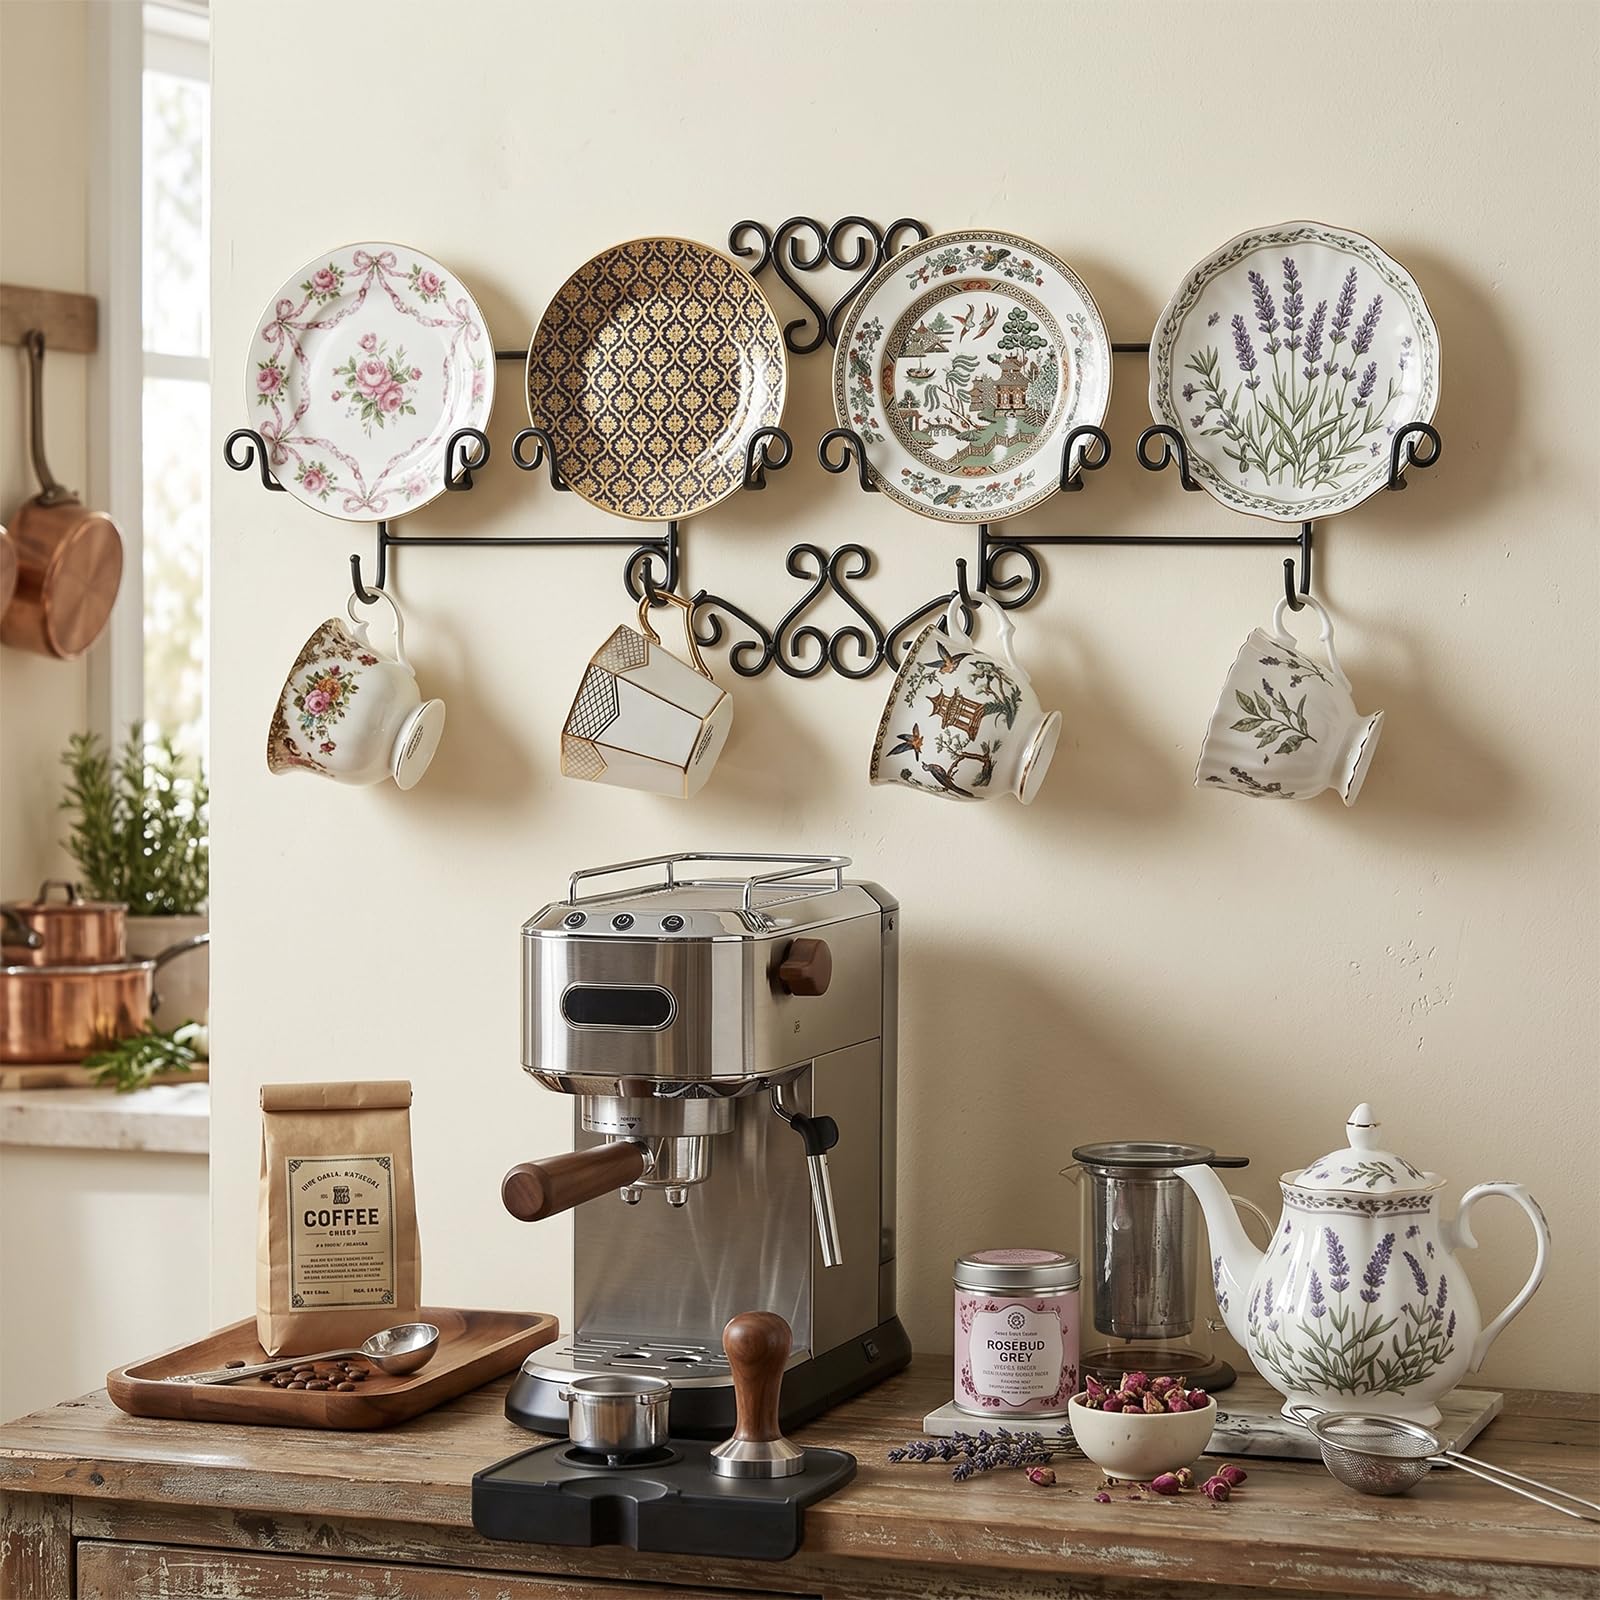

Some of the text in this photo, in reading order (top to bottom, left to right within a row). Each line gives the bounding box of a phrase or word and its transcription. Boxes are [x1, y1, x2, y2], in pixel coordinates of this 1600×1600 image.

[304, 1208, 379, 1227] COFFEE
[987, 1340, 1045, 1351] ROSEBUD
[999, 1352, 1033, 1362] GREY
